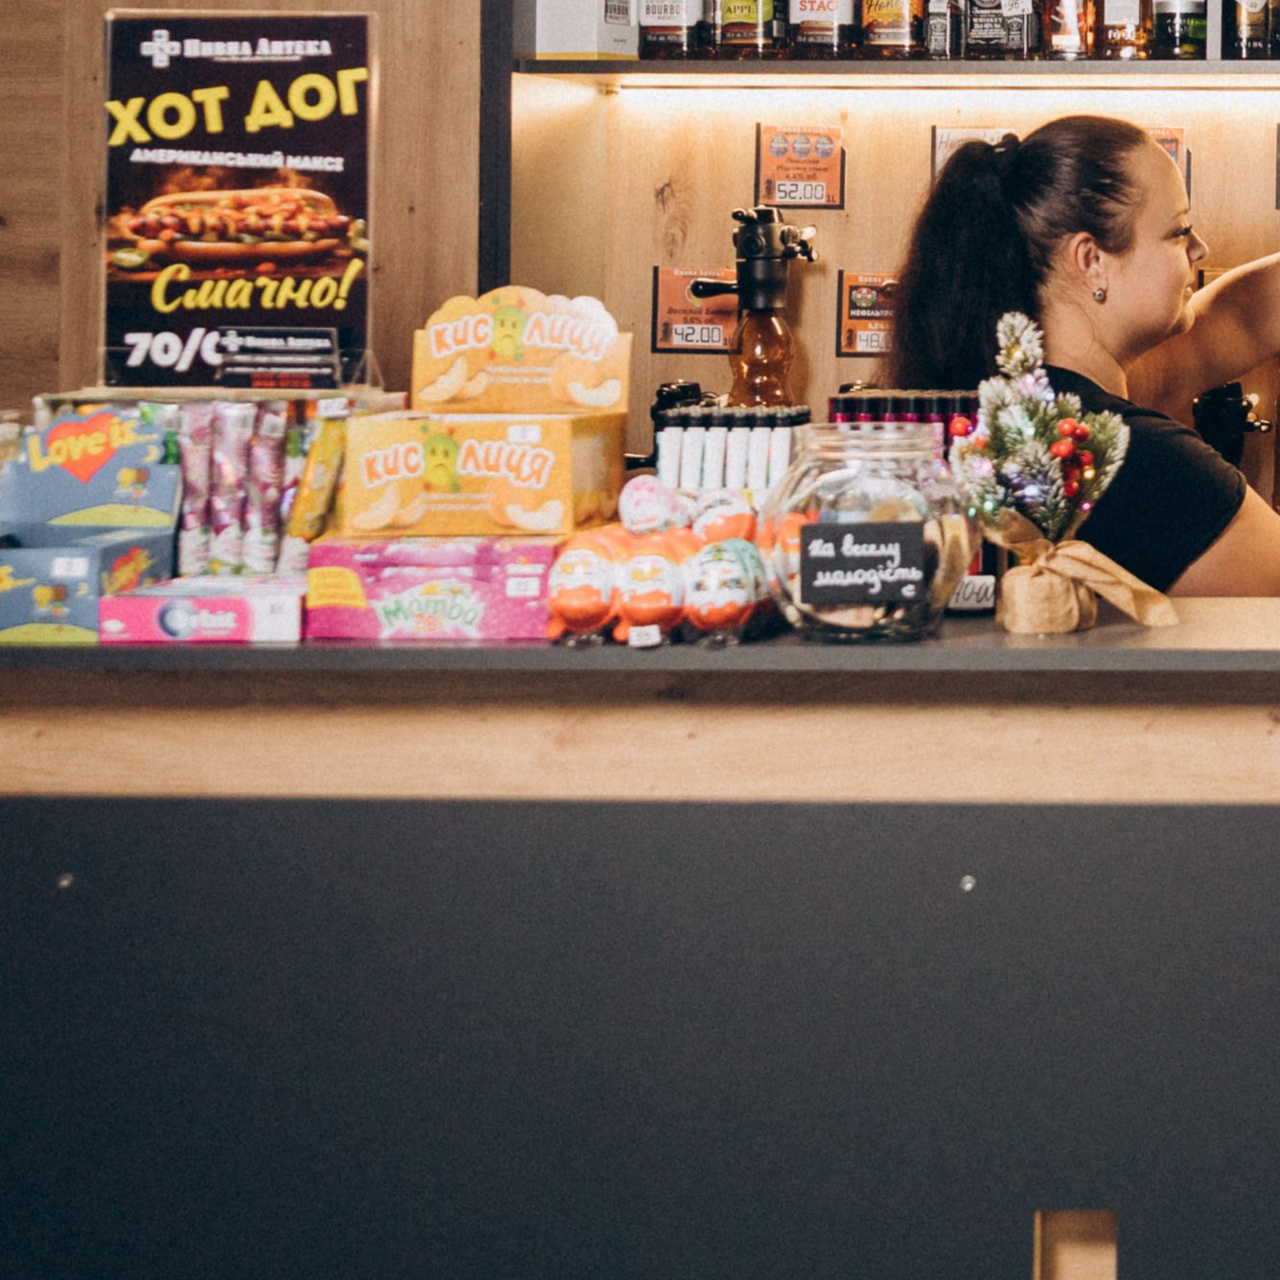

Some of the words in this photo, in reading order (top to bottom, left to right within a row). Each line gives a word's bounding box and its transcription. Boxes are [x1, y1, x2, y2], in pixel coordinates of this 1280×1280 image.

[105, 86, 230, 148] ХОТ
[244, 67, 369, 134] ДОГ
[776, 182, 825, 200] 52.00
[150, 257, 364, 314] Смачно!
[673, 326, 722, 344] 42.00
